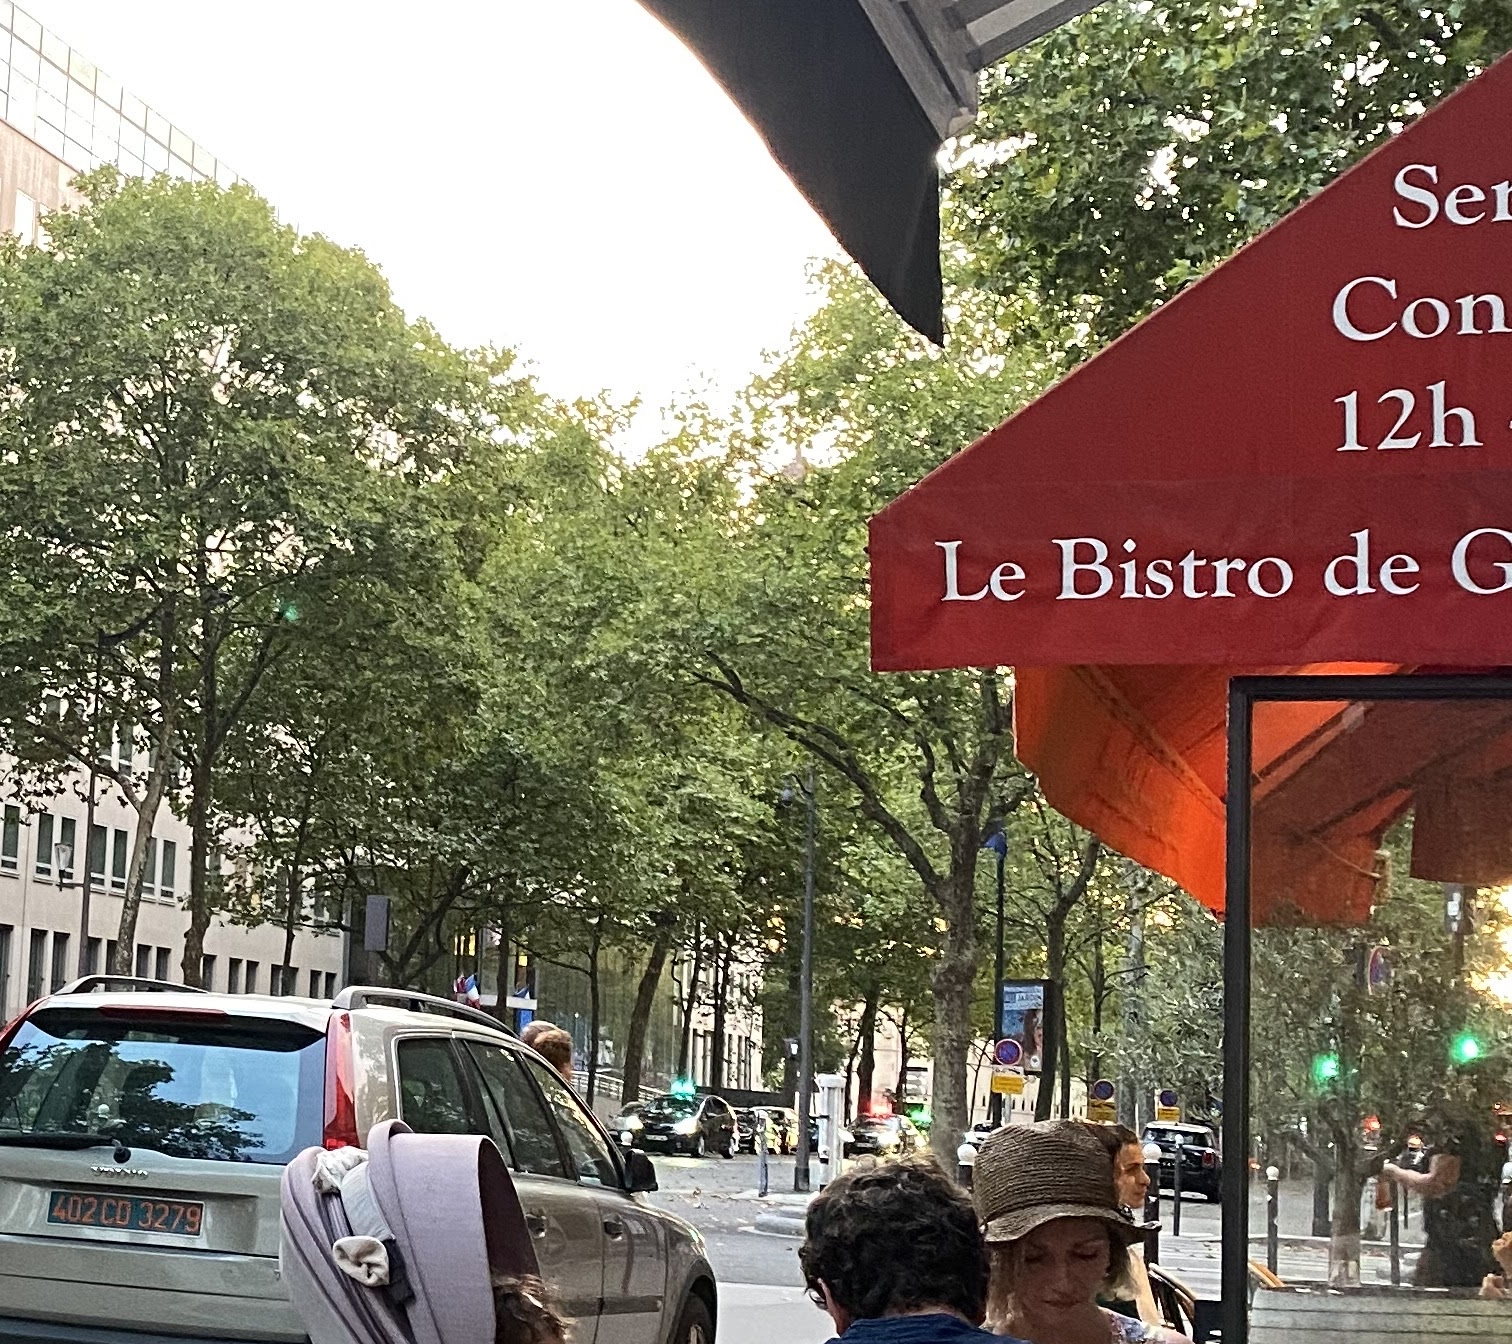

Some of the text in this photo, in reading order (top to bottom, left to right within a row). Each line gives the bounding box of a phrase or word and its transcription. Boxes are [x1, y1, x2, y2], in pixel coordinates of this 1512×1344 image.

[1332, 276, 1512, 341] Con
[1334, 380, 1484, 452] 12h
[934, 527, 1512, 602] Le Bistro de G
[138, 1201, 201, 1233] 3279
